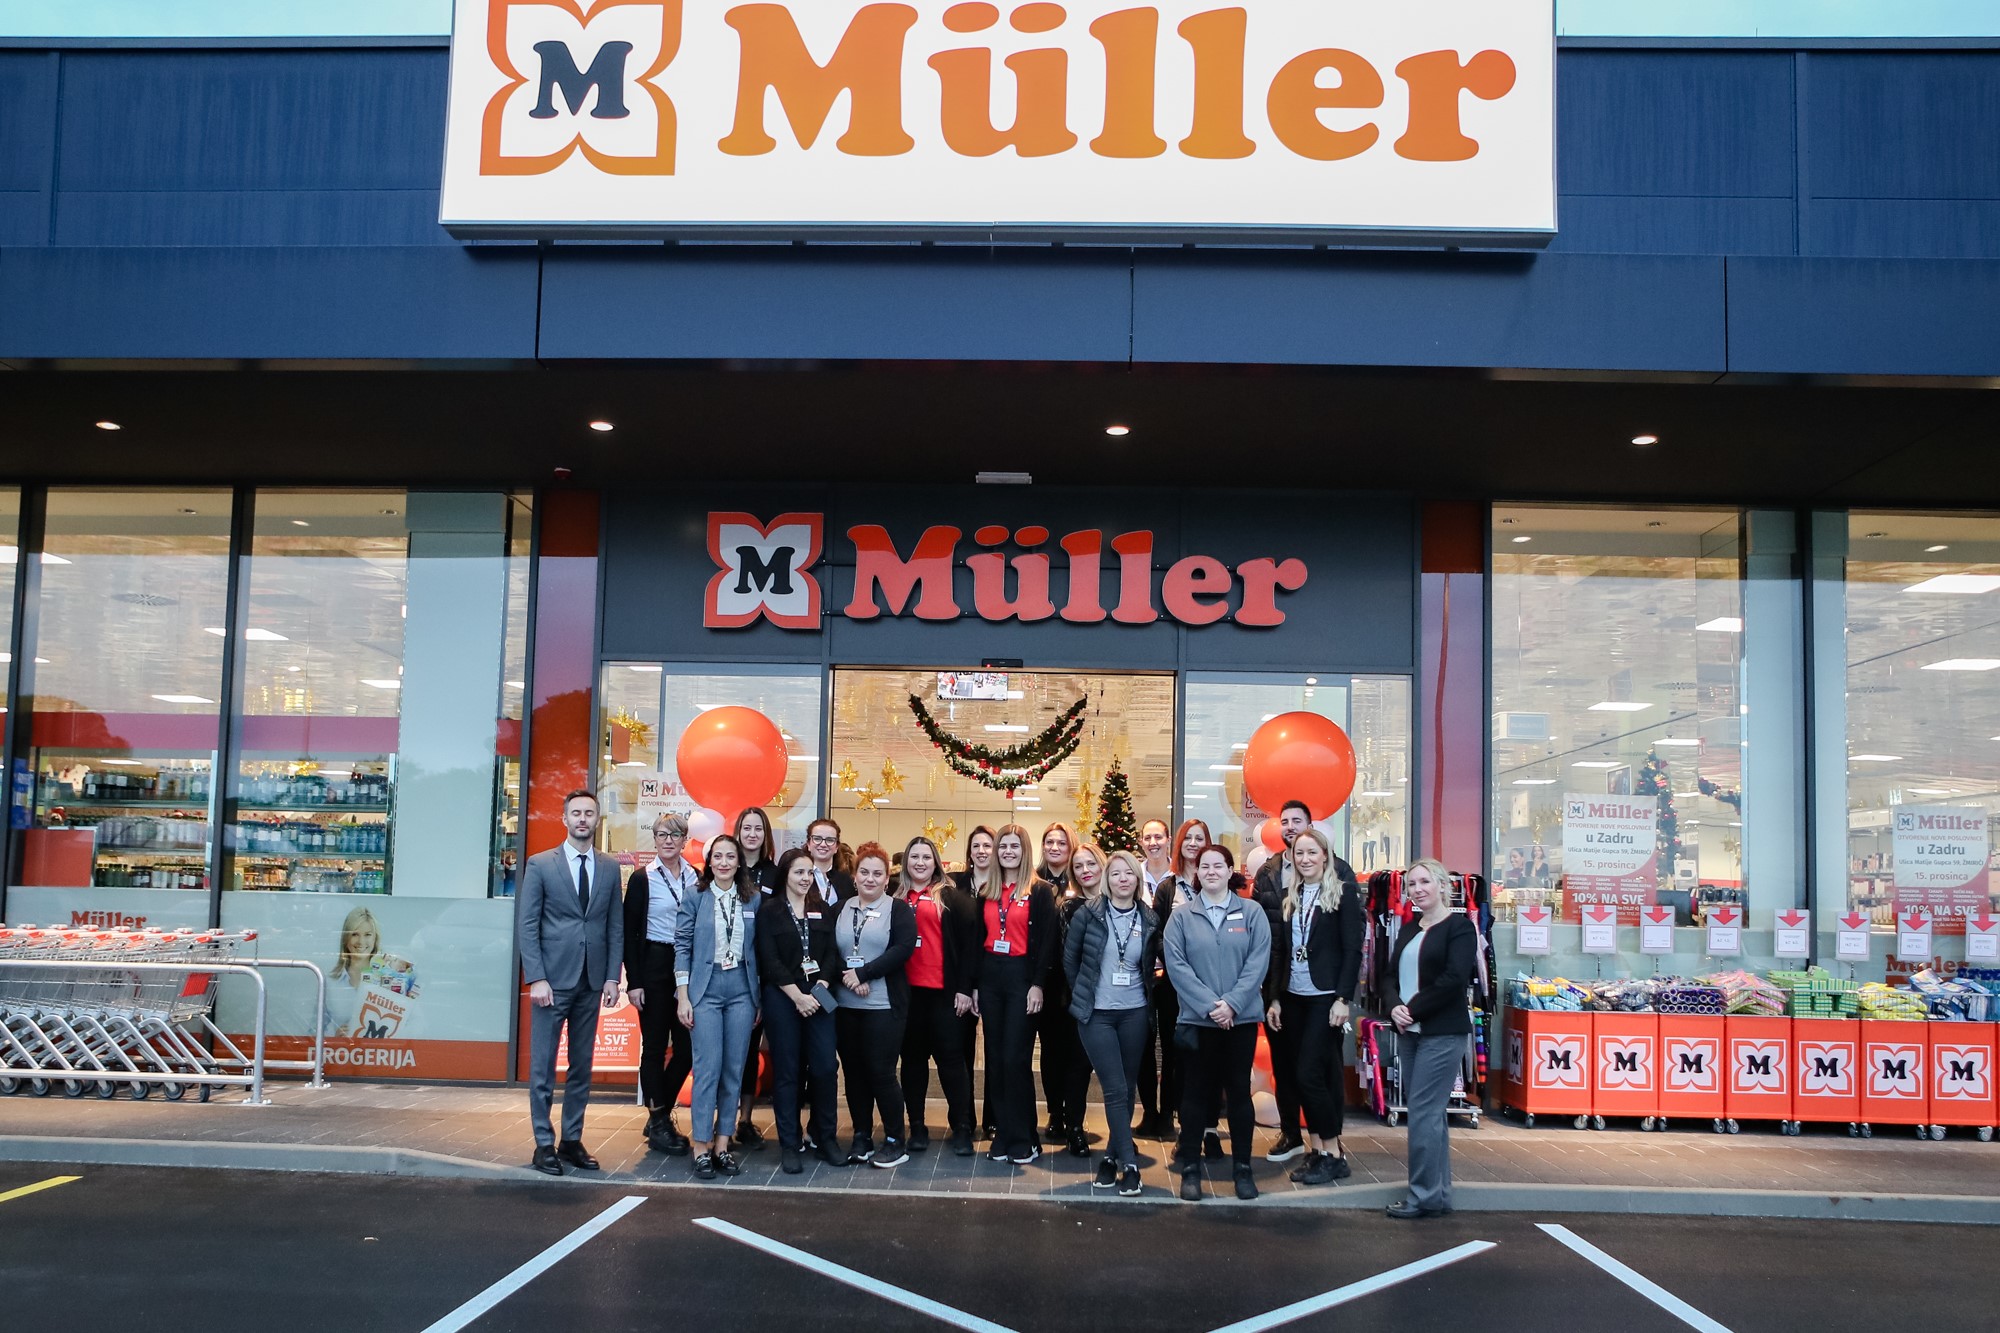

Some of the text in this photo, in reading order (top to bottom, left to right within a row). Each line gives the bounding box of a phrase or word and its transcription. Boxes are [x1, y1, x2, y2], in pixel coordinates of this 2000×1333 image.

[528, 0, 1517, 162] M Müller
[733, 525, 1308, 627] M Müller
[1588, 803, 1653, 820] Müller
[1918, 814, 1983, 830] Müller
[1586, 832, 1634, 844] u Zadru
[1917, 844, 1965, 855] u Zadru
[1598, 861, 1636, 870] prosinca
[1915, 872, 1968, 881] 15. prosinca
[1572, 893, 1597, 903] 10%
[1601, 894, 1618, 904] NA
[71, 911, 147, 928] Müller
[1934, 906, 1951, 915] NA
[366, 991, 405, 1014] Müller
[363, 1020, 388, 1039] M
[1547, 1050, 1571, 1070] M
[1614, 1051, 1637, 1072] M
[1679, 1053, 1703, 1074] M
[1746, 1054, 1771, 1075] M
[1813, 1056, 1838, 1077] M
[1882, 1058, 1906, 1079] M
[1950, 1060, 1975, 1081] M
